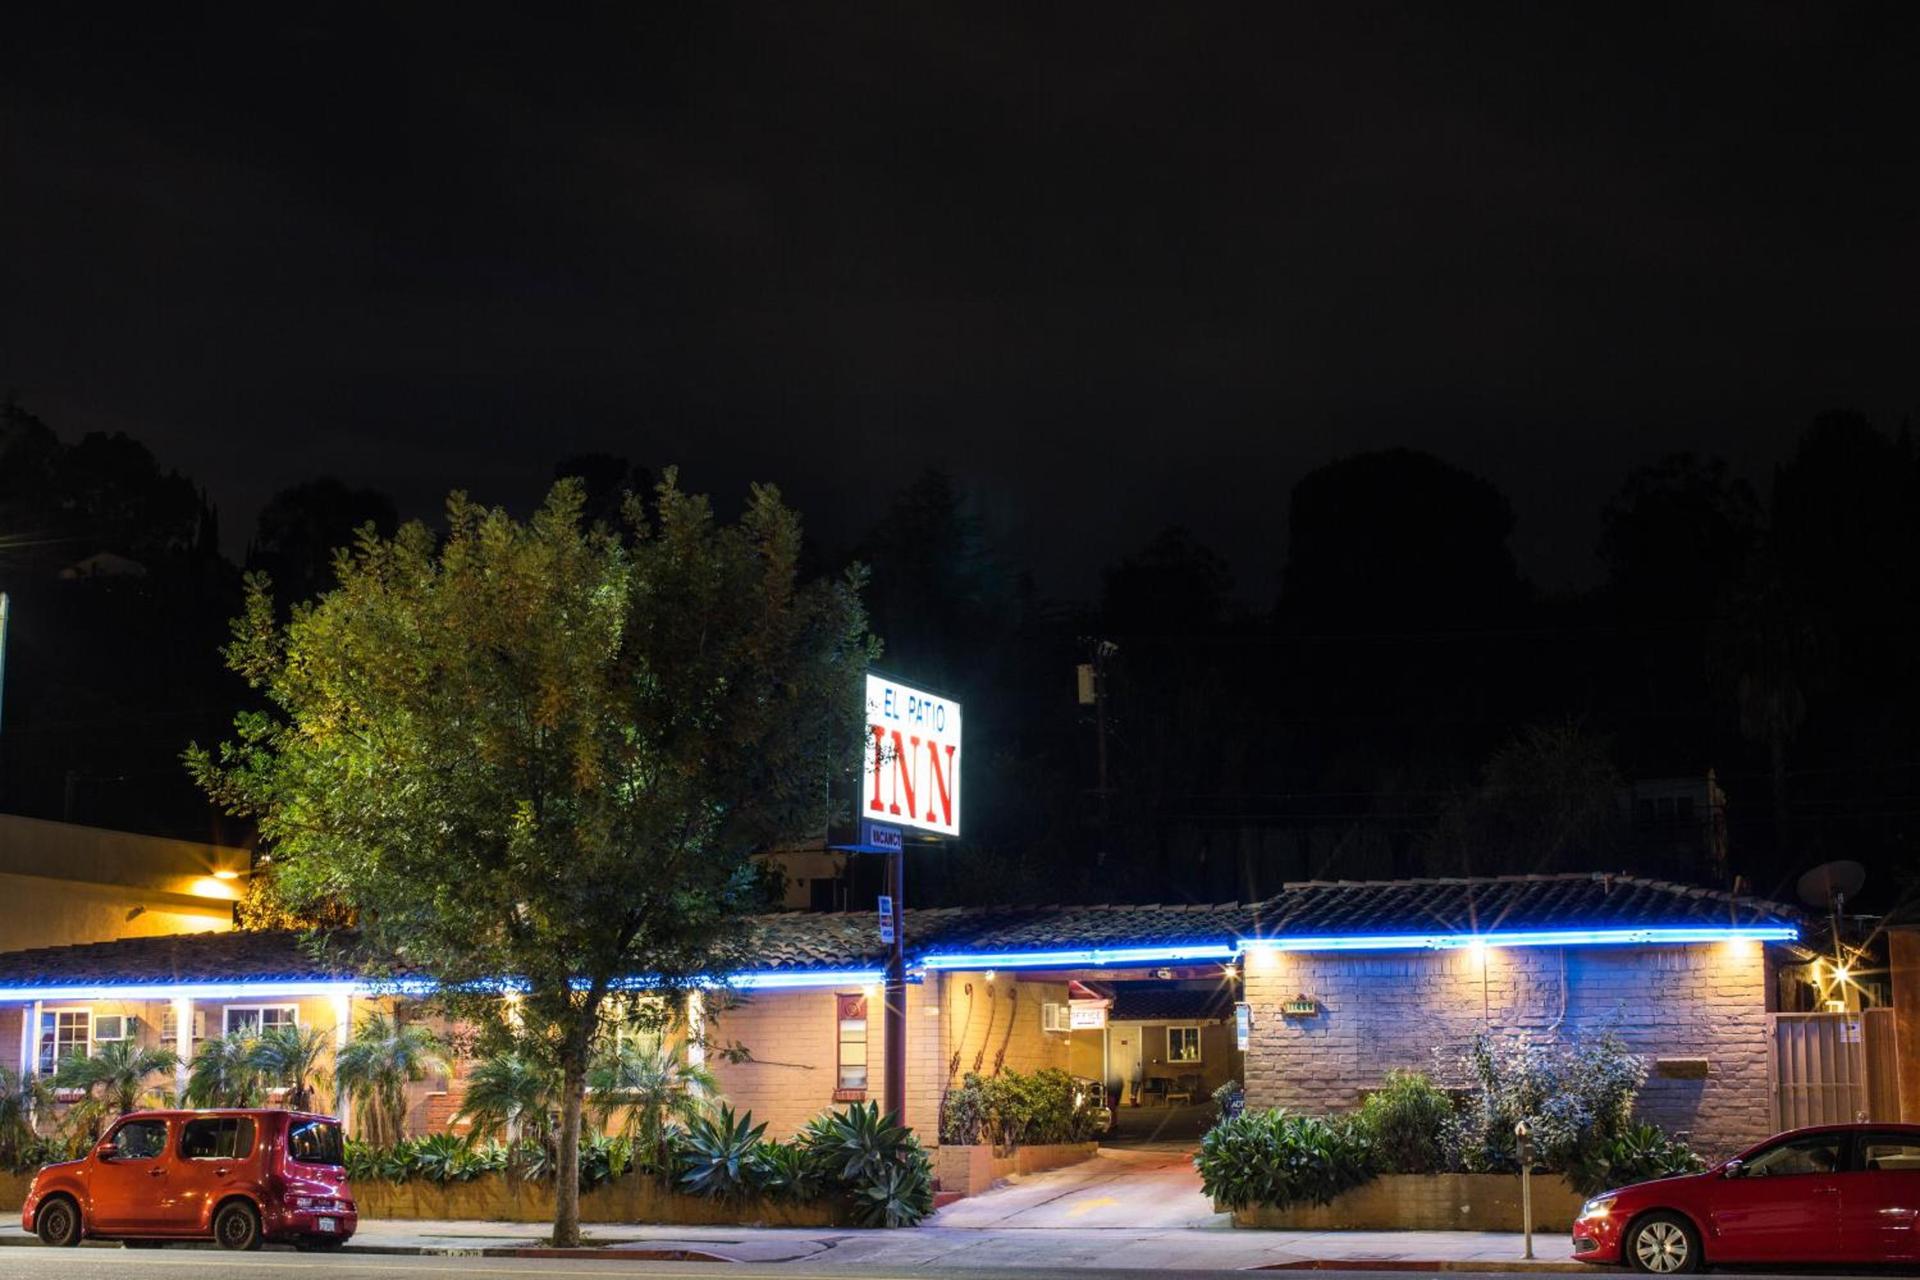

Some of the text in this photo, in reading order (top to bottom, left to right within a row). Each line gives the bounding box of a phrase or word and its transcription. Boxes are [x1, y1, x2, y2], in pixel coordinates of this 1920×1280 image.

[884, 688, 945, 732] EL PATIO
[869, 724, 956, 826] INN
[872, 829, 902, 847] VACANCY
